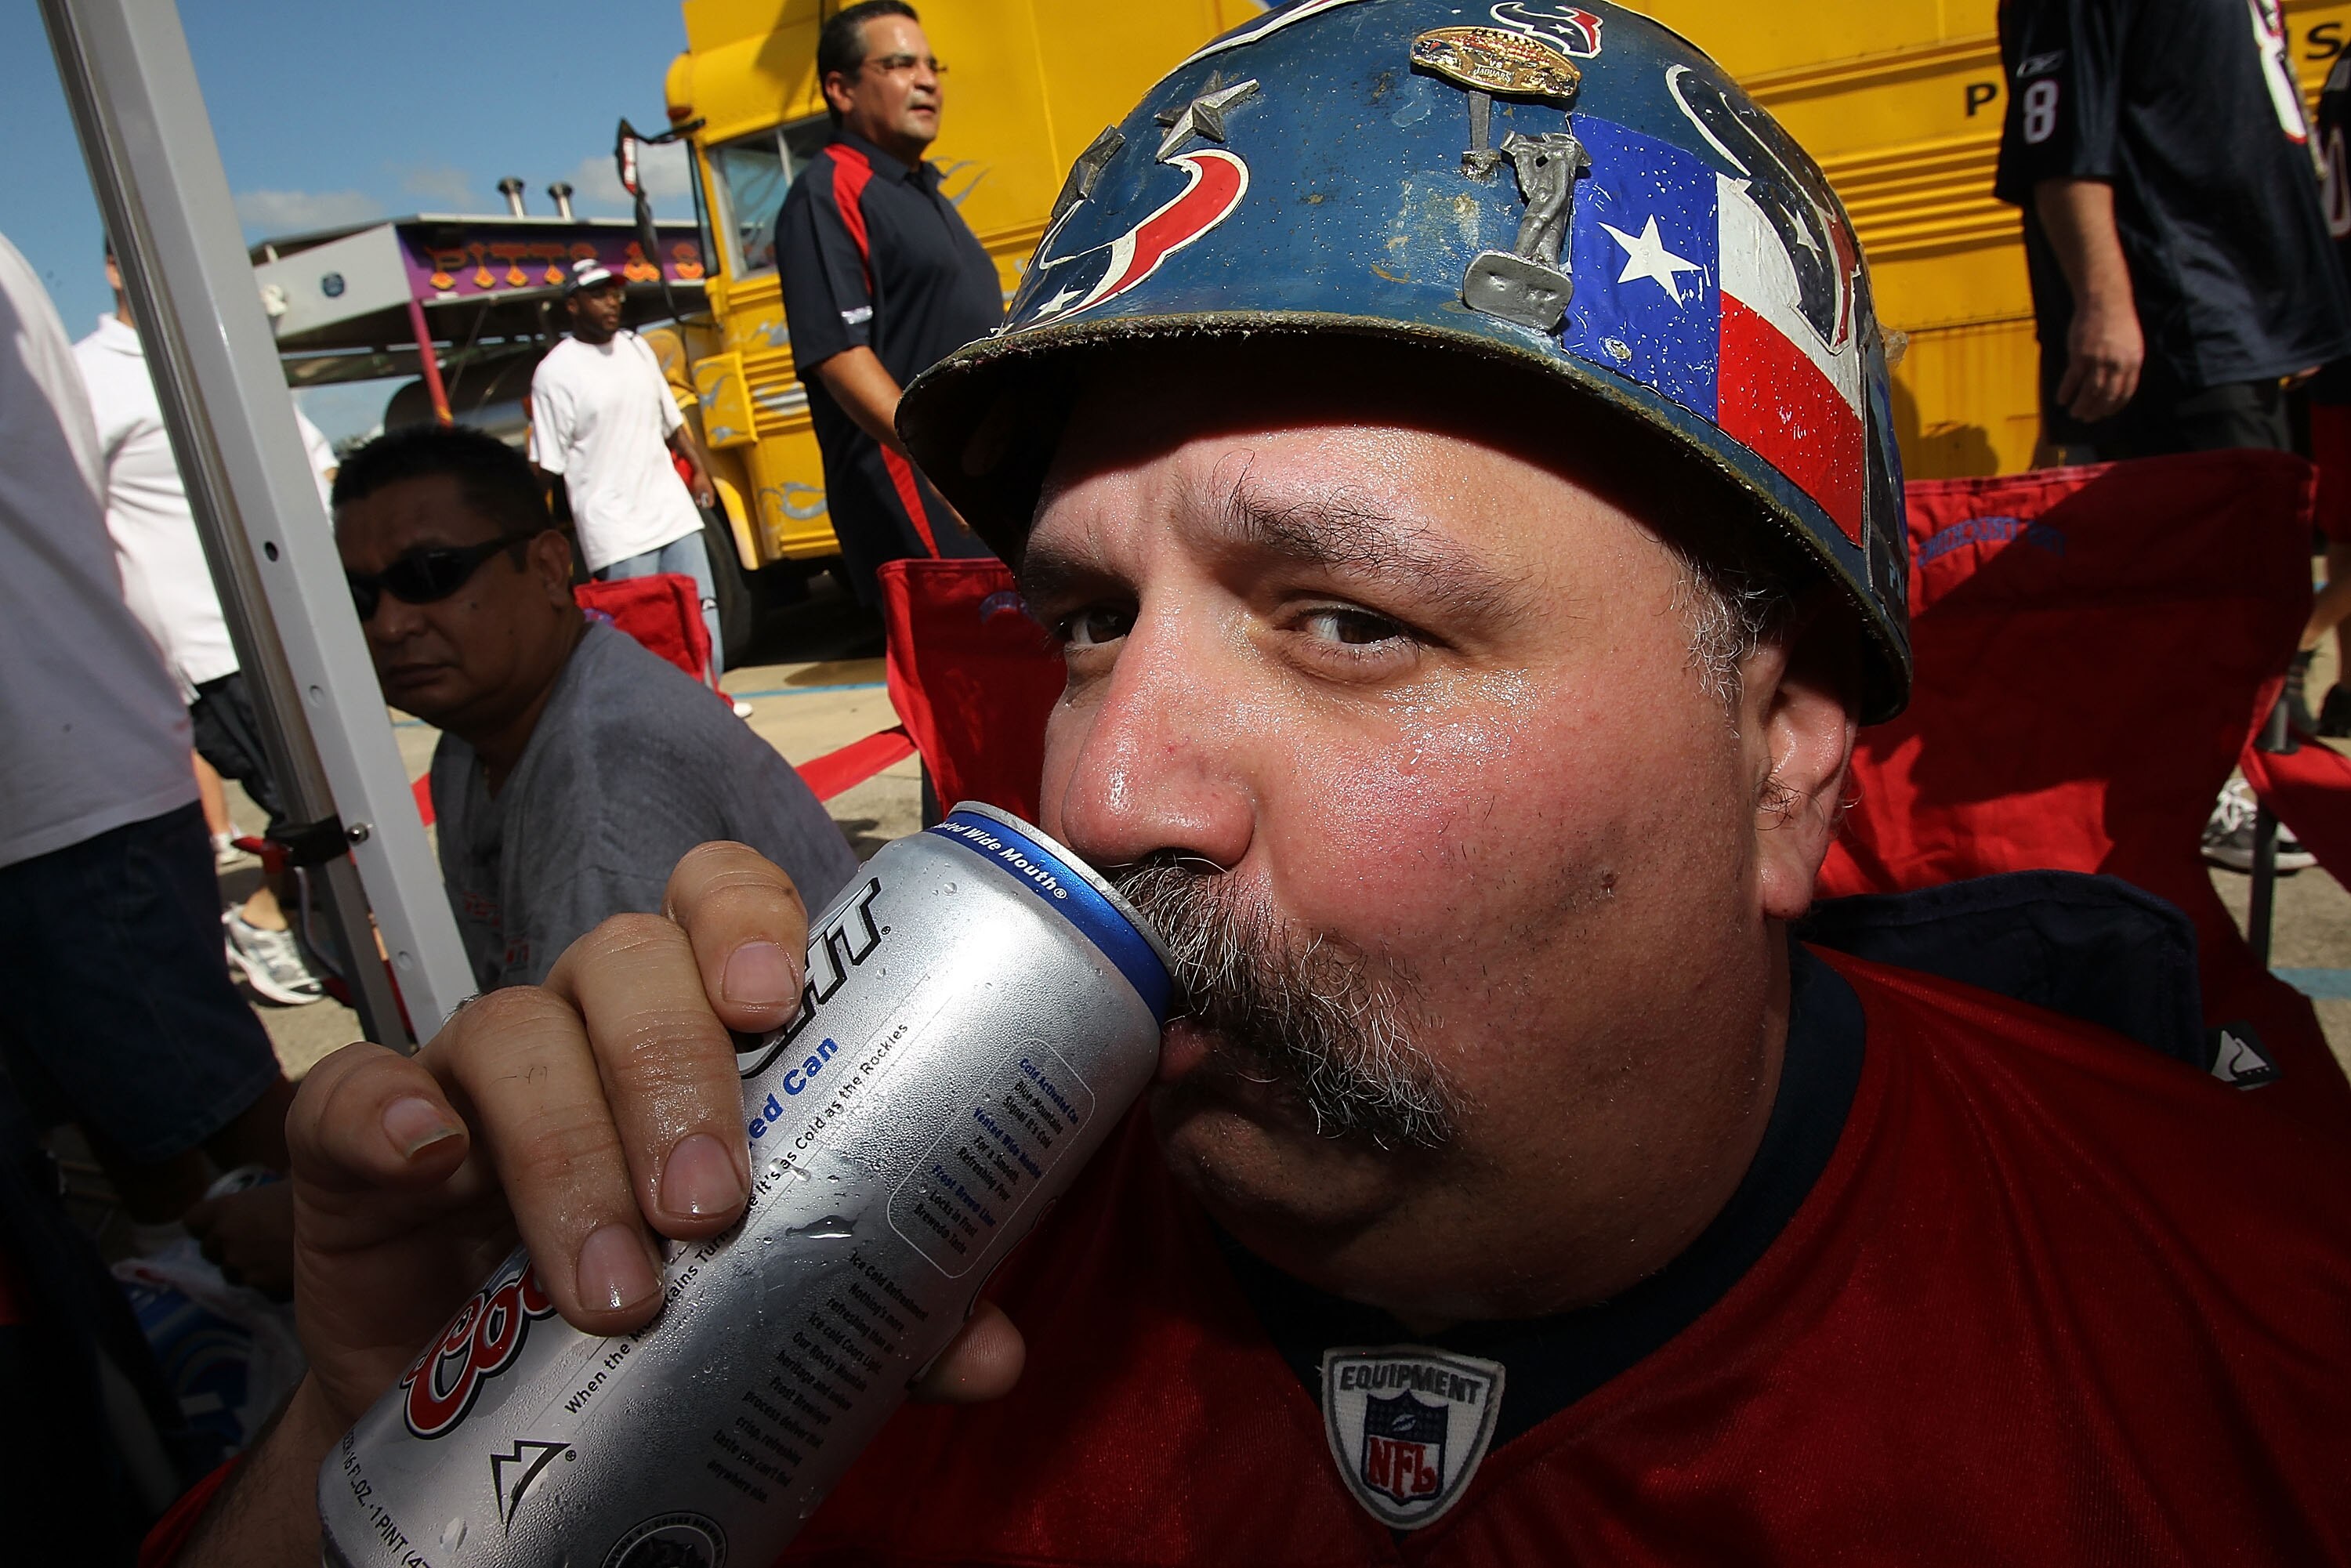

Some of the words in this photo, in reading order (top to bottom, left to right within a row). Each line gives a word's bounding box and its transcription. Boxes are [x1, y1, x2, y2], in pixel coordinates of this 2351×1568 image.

[1472, 64, 1515, 85] JAGUARS
[966, 824, 1002, 854] Wide
[782, 1034, 839, 1096] Can
[1020, 1059, 1040, 1080] Cold
[1039, 1077, 1070, 1113] Activated
[1003, 1096, 1028, 1122] Signal
[1025, 1118, 1038, 1135] It's
[1037, 1131, 1052, 1149] Cold
[1014, 1081, 1033, 1102] Blue
[1033, 1099, 1063, 1134] Mountains
[974, 1109, 1003, 1139] Vented
[1002, 1135, 1020, 1156] Wide
[974, 1135, 990, 1152] For
[933, 1165, 957, 1190] Frost
[958, 1148, 996, 1189] Refreshing
[995, 1183, 1010, 1201] Pour
[566, 1372, 606, 1413] When
[604, 1343, 630, 1369] the
[697, 1227, 730, 1260] Turn
[755, 1172, 781, 1194] It's
[780, 1152, 797, 1170] as
[795, 1117, 825, 1150] Cold
[824, 1101, 842, 1117] as
[839, 1077, 861, 1099] the
[860, 1026, 907, 1074] Rockies
[929, 1191, 953, 1215] Locks
[951, 1210, 961, 1222] in
[959, 1217, 978, 1237] Frost
[849, 1254, 866, 1269] Ice
[865, 1266, 887, 1287] Cold
[885, 1282, 928, 1320] Refreshment
[828, 1298, 870, 1336] refreshing
[850, 1284, 887, 1318] Nothing's
[886, 1315, 904, 1332] more
[793, 1331, 811, 1349] Our
[810, 1345, 835, 1370] Rocky
[823, 1327, 845, 1345] cold
[842, 1339, 864, 1361] Coors
[777, 1351, 814, 1384] heritage
[1339, 1363, 1483, 1405] EQUIPMENT
[743, 1392, 781, 1421] process
[770, 1377, 795, 1400] Frost
[343, 1451, 357, 1470] 16
[713, 1430, 739, 1454] taste
[737, 1451, 759, 1467] you
[1367, 1436, 1438, 1497] NFL
[708, 1461, 748, 1490] anywhere
[370, 1506, 383, 1522] 1
[375, 1516, 408, 1555] PINT
